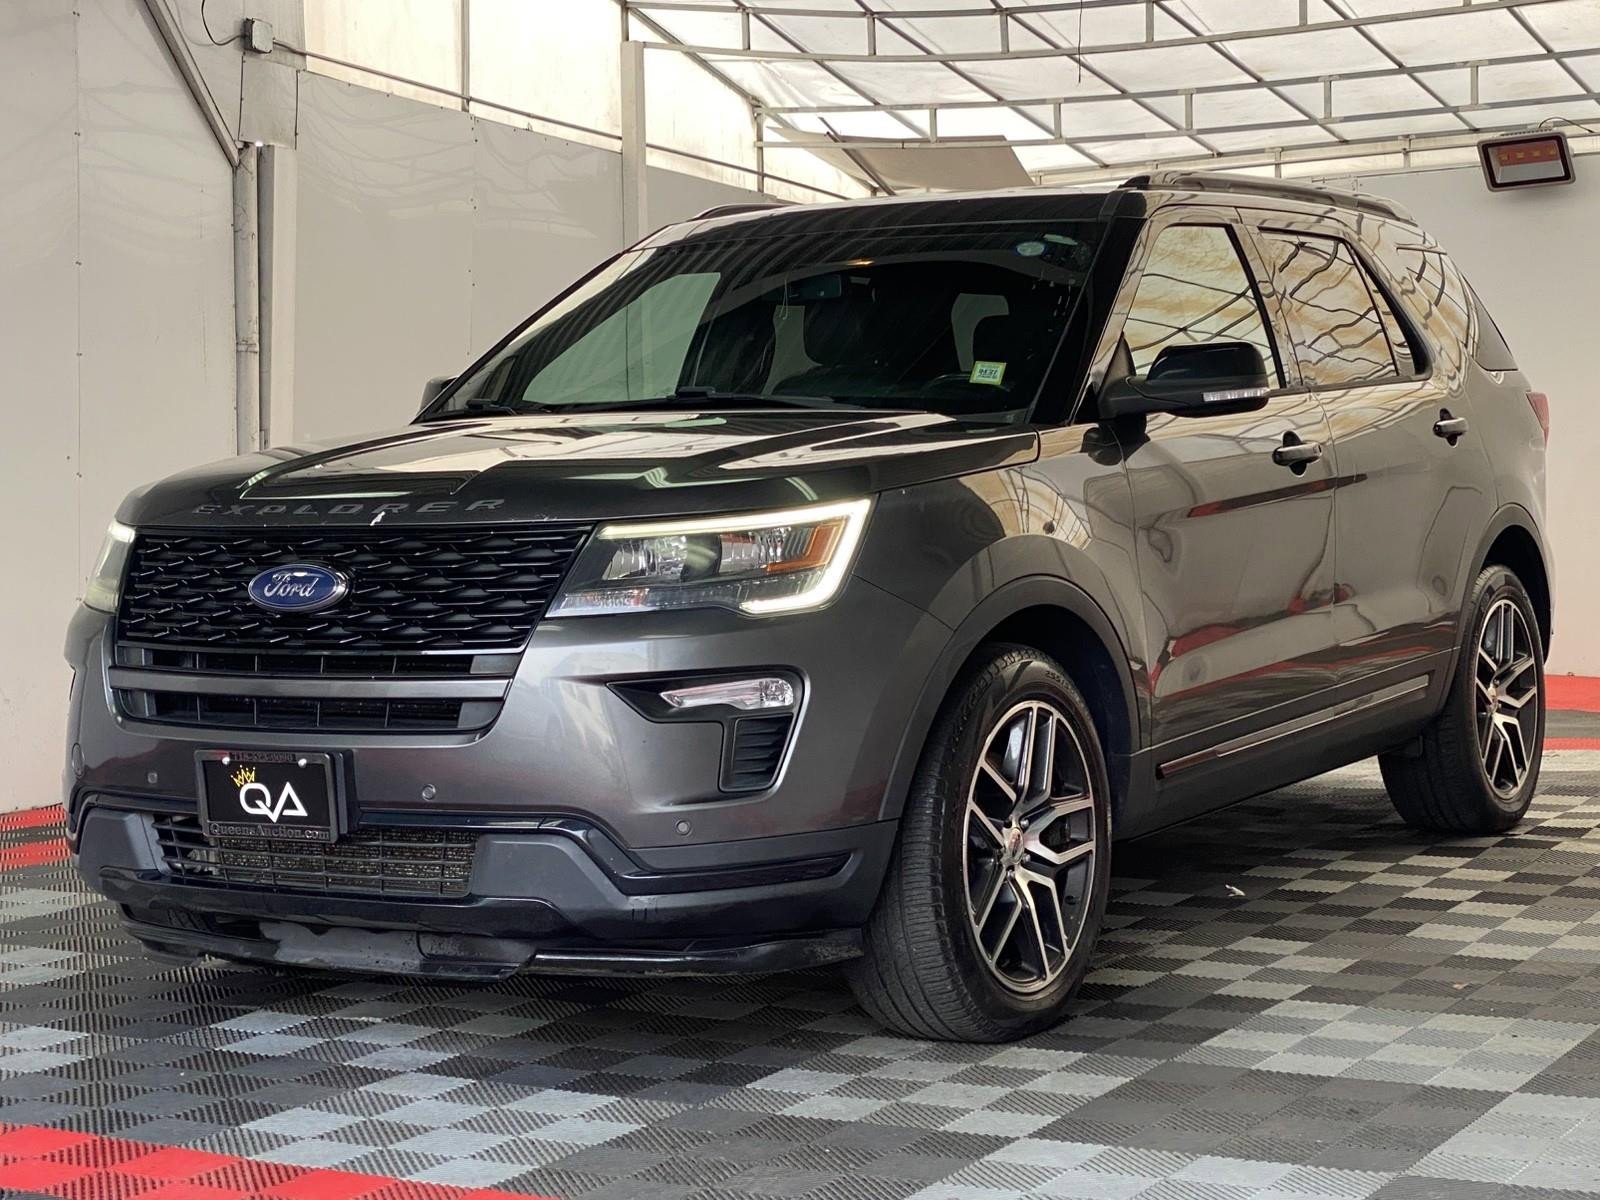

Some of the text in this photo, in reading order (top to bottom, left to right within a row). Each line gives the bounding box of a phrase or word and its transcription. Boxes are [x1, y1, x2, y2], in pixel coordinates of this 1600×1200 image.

[192, 499, 504, 516] EXPLORER
[263, 573, 319, 598] Ford
[239, 782, 308, 823] QA
[210, 822, 330, 840] QueensAuction.com
